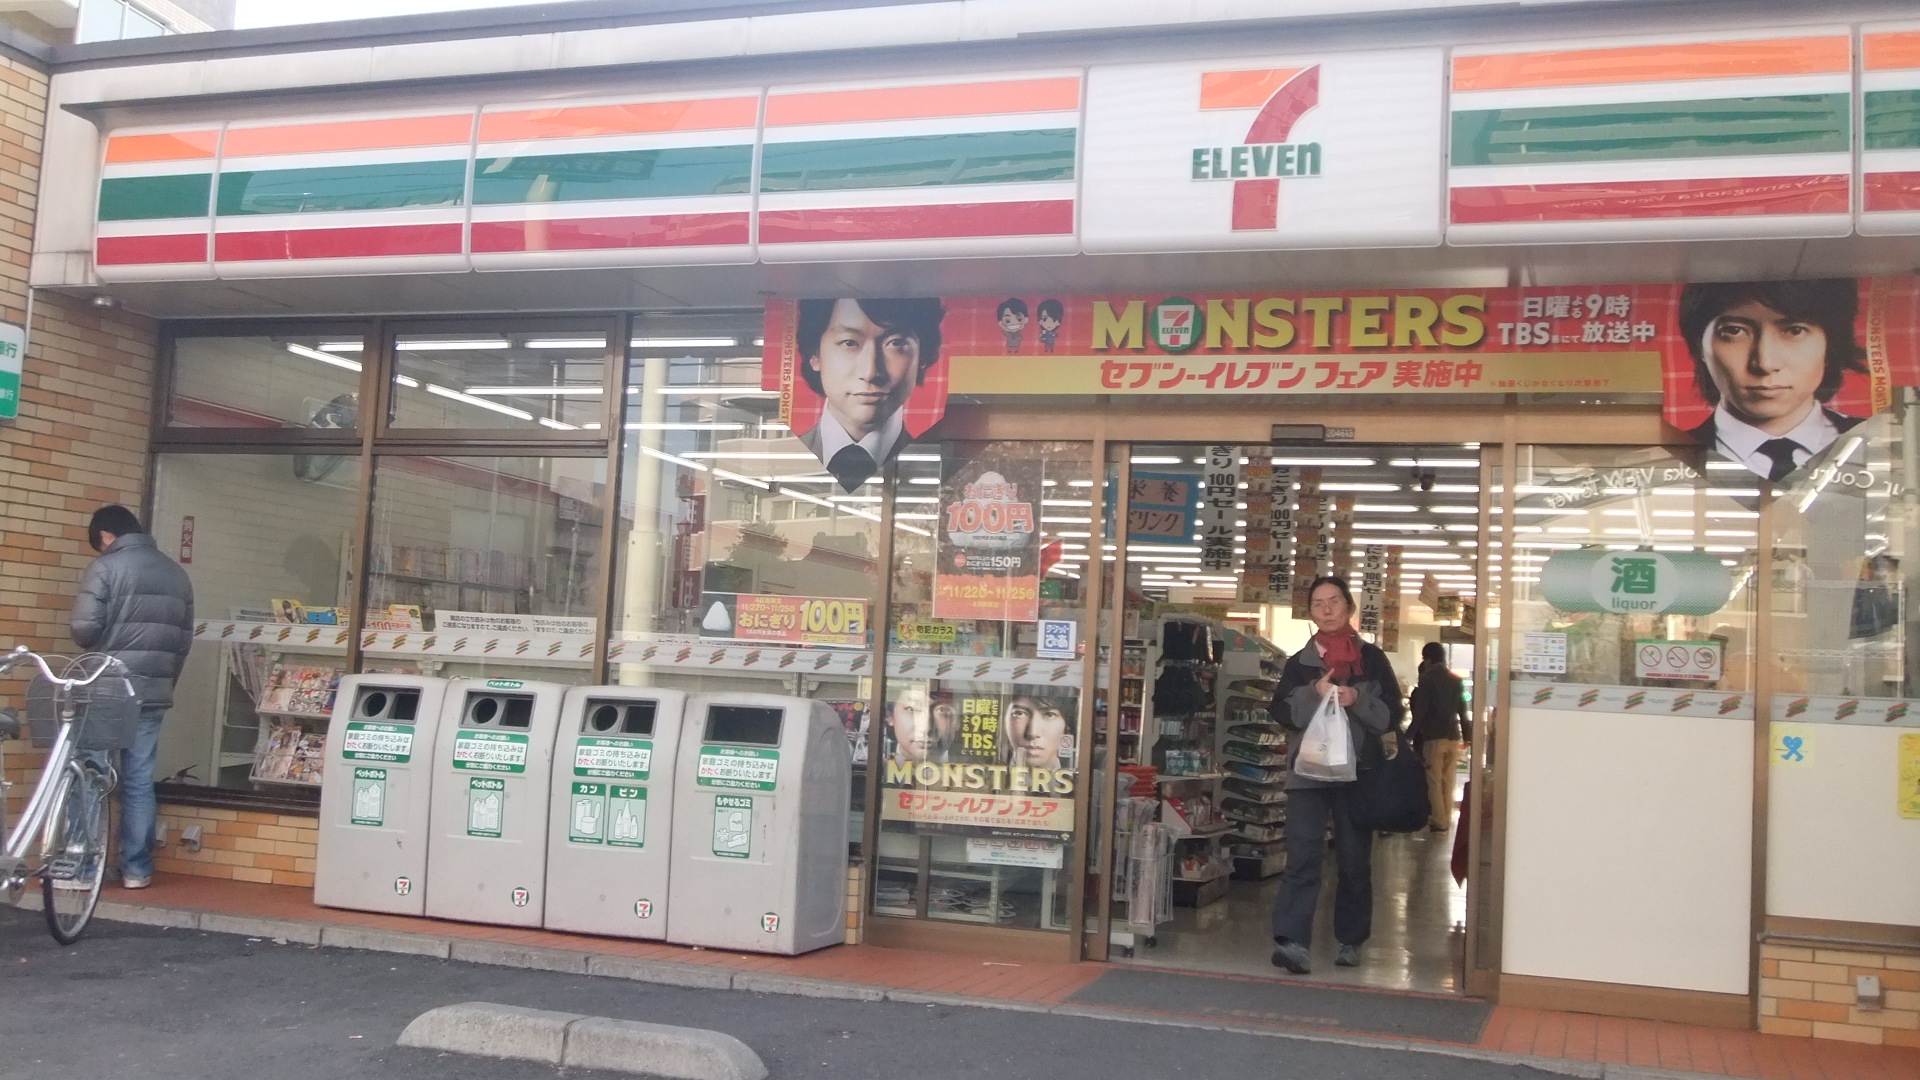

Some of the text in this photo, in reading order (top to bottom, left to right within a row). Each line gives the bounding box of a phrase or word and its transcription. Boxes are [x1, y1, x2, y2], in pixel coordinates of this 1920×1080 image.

[1314, 361, 1388, 388] フェア
[1392, 360, 1483, 388] 実施中
[946, 502, 1035, 533] 100円
[1611, 557, 1657, 595] 酒
[1612, 597, 1657, 611] liquor
[738, 612, 796, 630] おにぎり
[800, 600, 864, 634] 100円
[347, 732, 411, 744] 家庭ゴミの持ち込みは
[457, 741, 524, 754] 家庭ゴミの持ち込みは
[578, 748, 648, 760] 家庭ゴミの持ち込みは
[701, 757, 775, 770] 家庭ゴミの持ち込みは
[884, 759, 1074, 794] MONSTERS
[579, 785, 598, 794] カン
[619, 787, 638, 798] ビン
[1017, 800, 1059, 818] フェア
